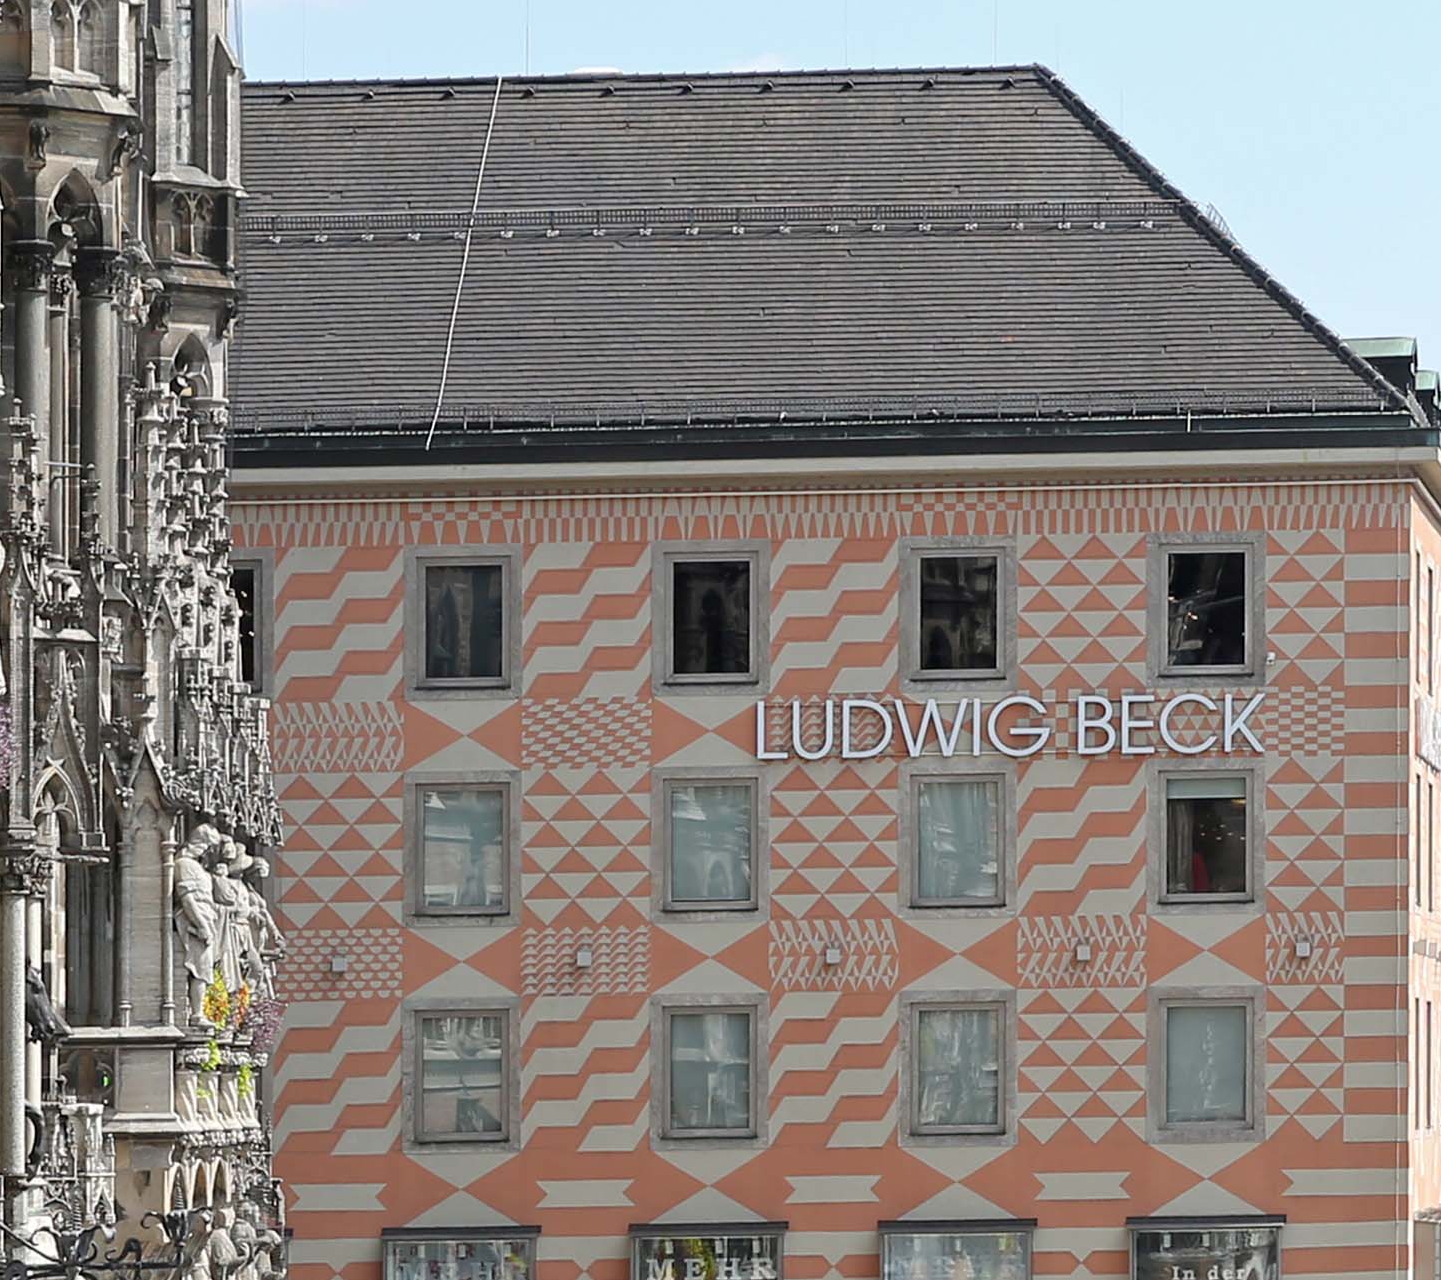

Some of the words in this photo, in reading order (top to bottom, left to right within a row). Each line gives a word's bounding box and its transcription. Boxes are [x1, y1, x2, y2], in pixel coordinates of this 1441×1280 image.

[756, 696, 1051, 760] LUDWIG
[1077, 693, 1266, 756] BECK
[1172, 1266, 1196, 1280] In
[1207, 1265, 1246, 1280] der
